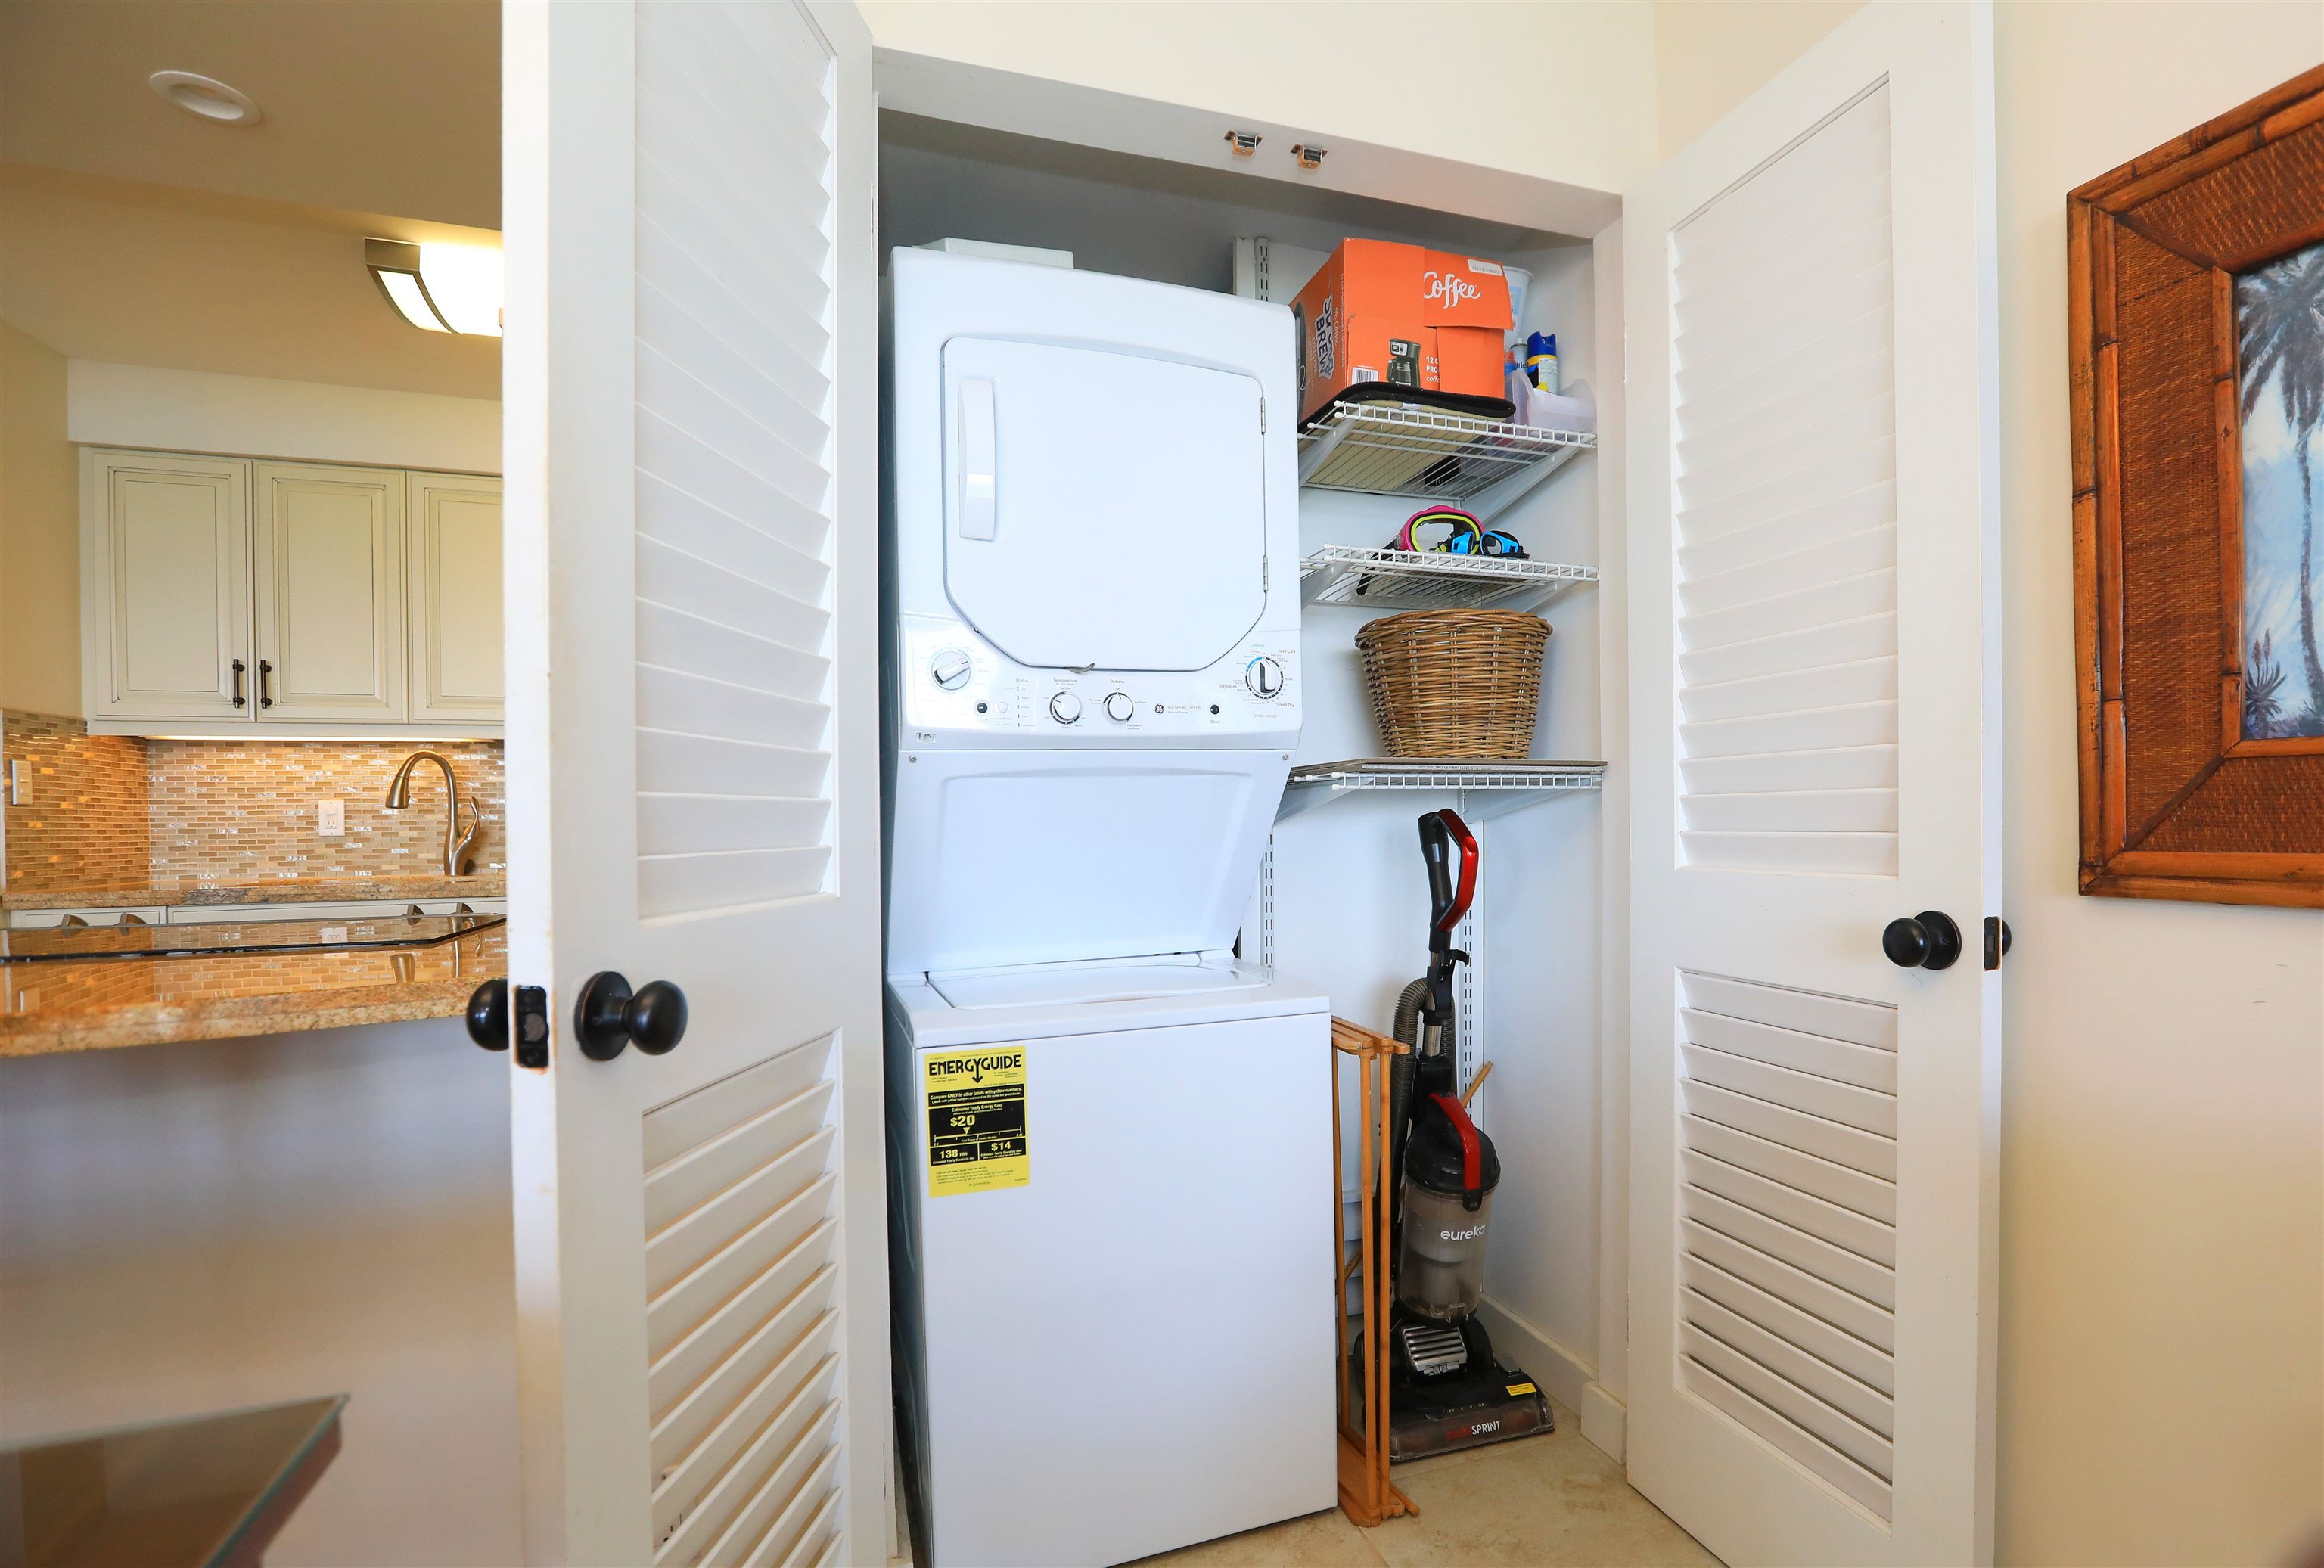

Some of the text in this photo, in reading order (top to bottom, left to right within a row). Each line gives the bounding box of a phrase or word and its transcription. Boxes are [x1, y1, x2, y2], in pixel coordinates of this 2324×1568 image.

[1423, 271, 1483, 309] Coffee
[1316, 317, 1328, 374] BREW
[929, 1054, 1022, 1076] ENERGYGUIDE
[950, 1114, 976, 1127] $20
[939, 1149, 958, 1159] 138
[991, 1141, 1011, 1152] $14
[1440, 1224, 1486, 1241] eureka
[1471, 1420, 1501, 1435] SPRINT
